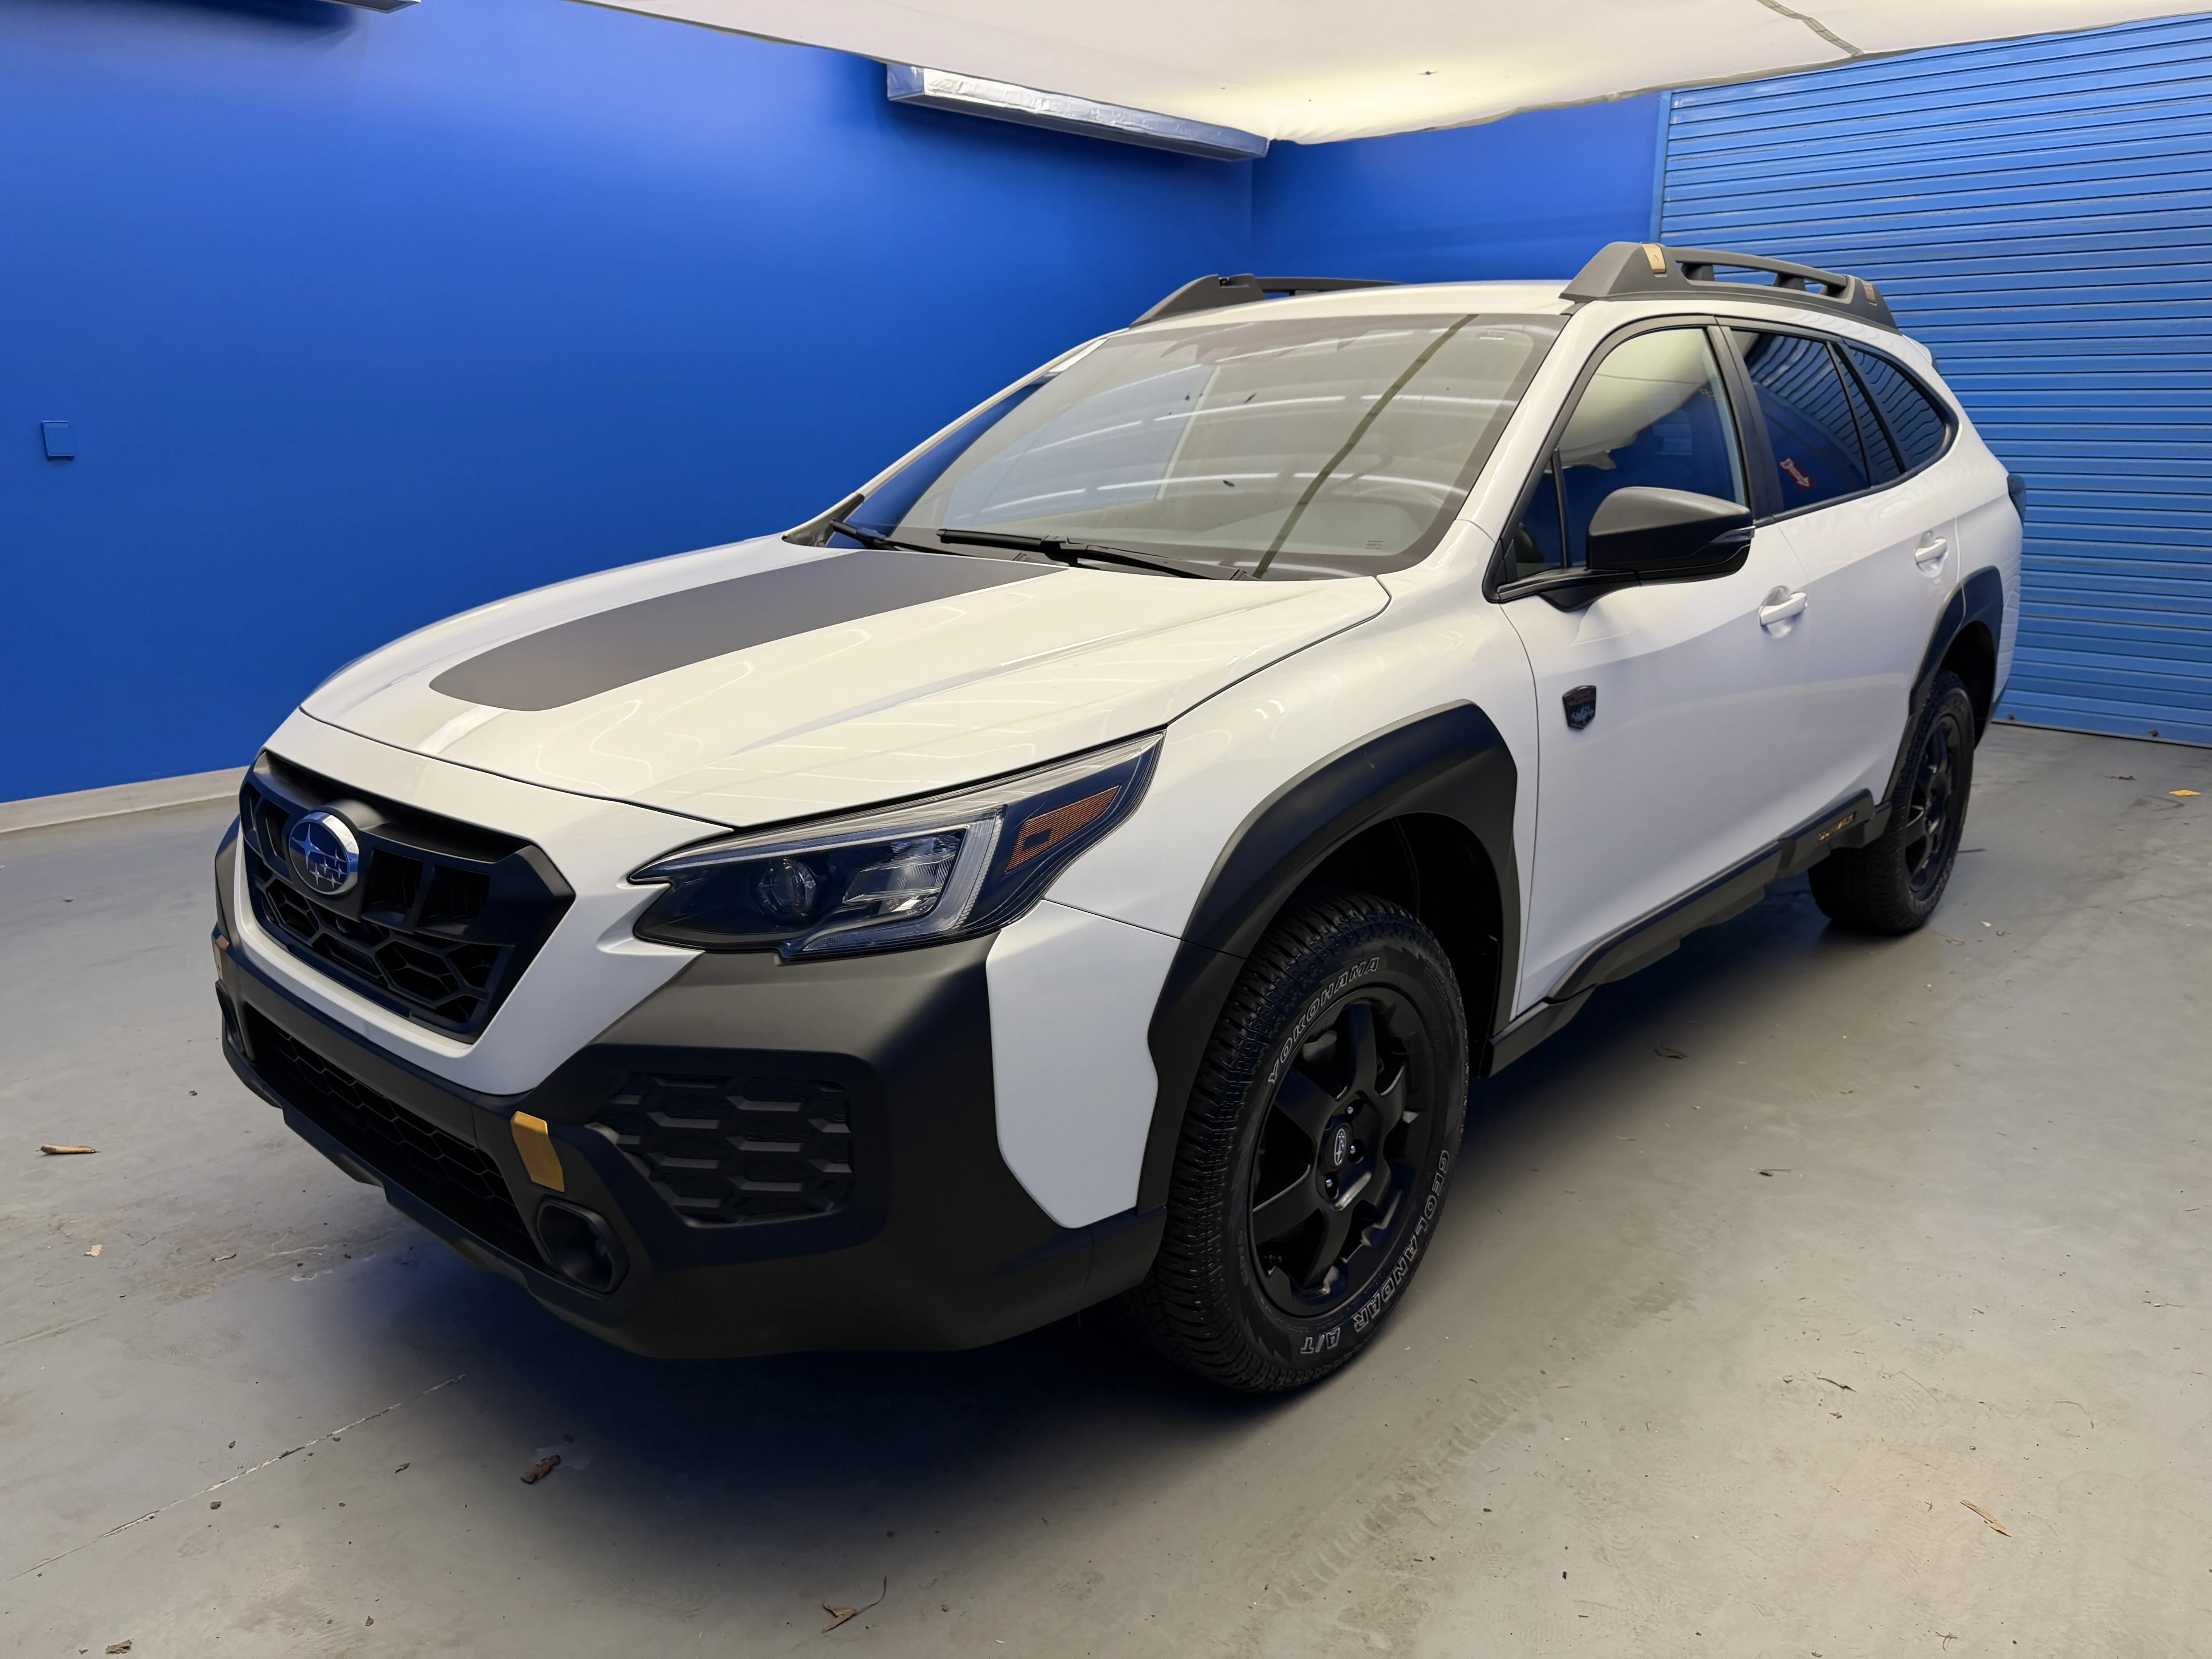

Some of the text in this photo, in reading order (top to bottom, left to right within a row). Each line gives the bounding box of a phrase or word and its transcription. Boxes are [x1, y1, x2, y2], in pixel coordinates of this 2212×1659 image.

[1268, 957, 1379, 1083] YOKOHAMA
[1300, 1150, 1449, 1354] GEOLANDAR A/T
